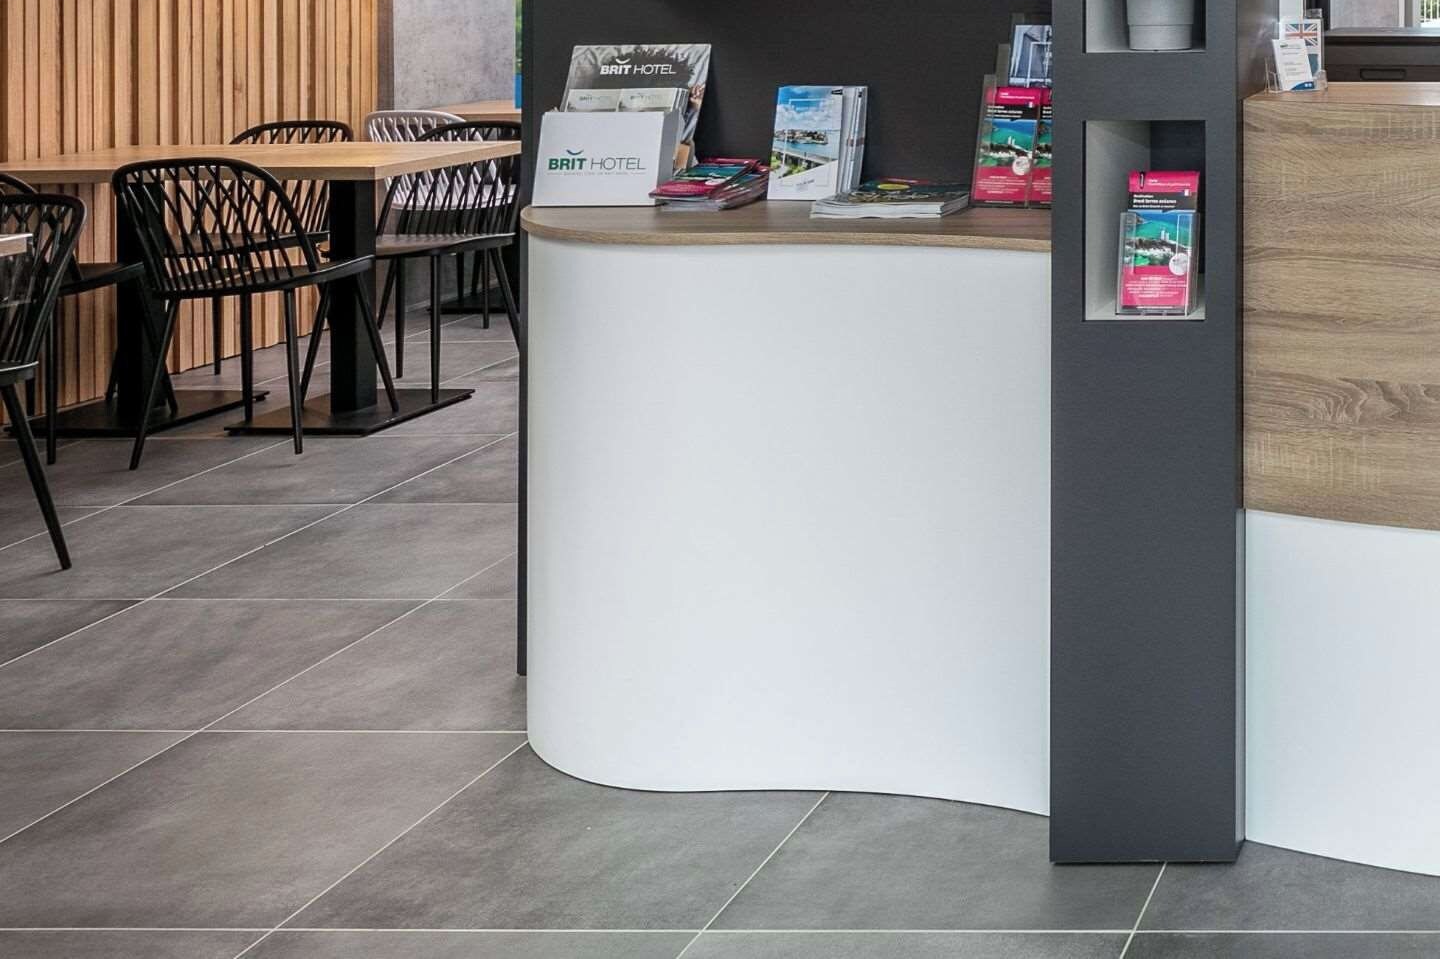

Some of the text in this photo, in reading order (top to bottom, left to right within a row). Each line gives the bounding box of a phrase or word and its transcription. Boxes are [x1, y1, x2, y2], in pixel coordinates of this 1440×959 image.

[600, 64, 677, 75] BRIT HOTEL
[548, 157, 646, 170] BRIT HOTEL
